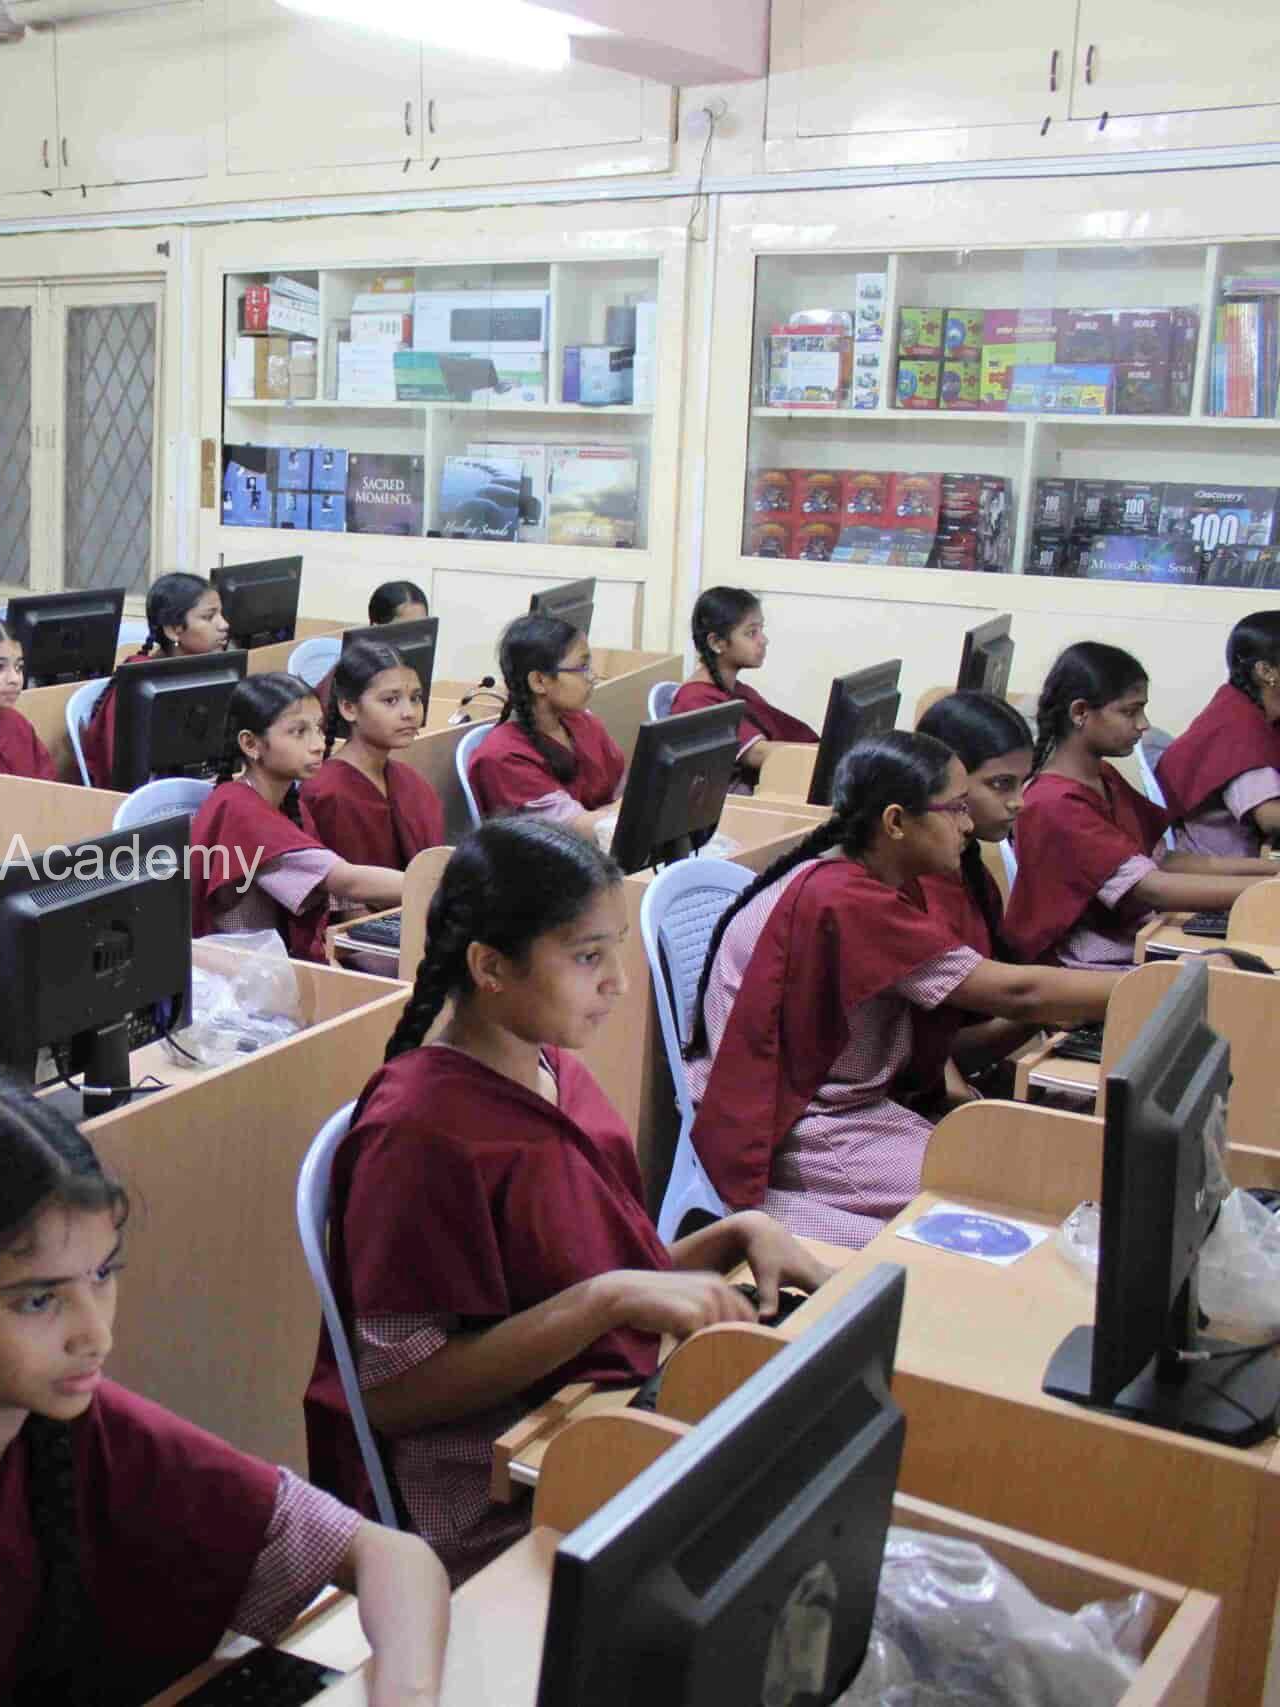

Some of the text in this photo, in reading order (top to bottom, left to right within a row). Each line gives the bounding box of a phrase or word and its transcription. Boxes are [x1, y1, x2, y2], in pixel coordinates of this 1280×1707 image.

[362, 476, 405, 491] SACRED
[355, 491, 412, 505] MOMENTS
[1125, 498, 1145, 514] 100
[1190, 513, 1239, 551] 100
